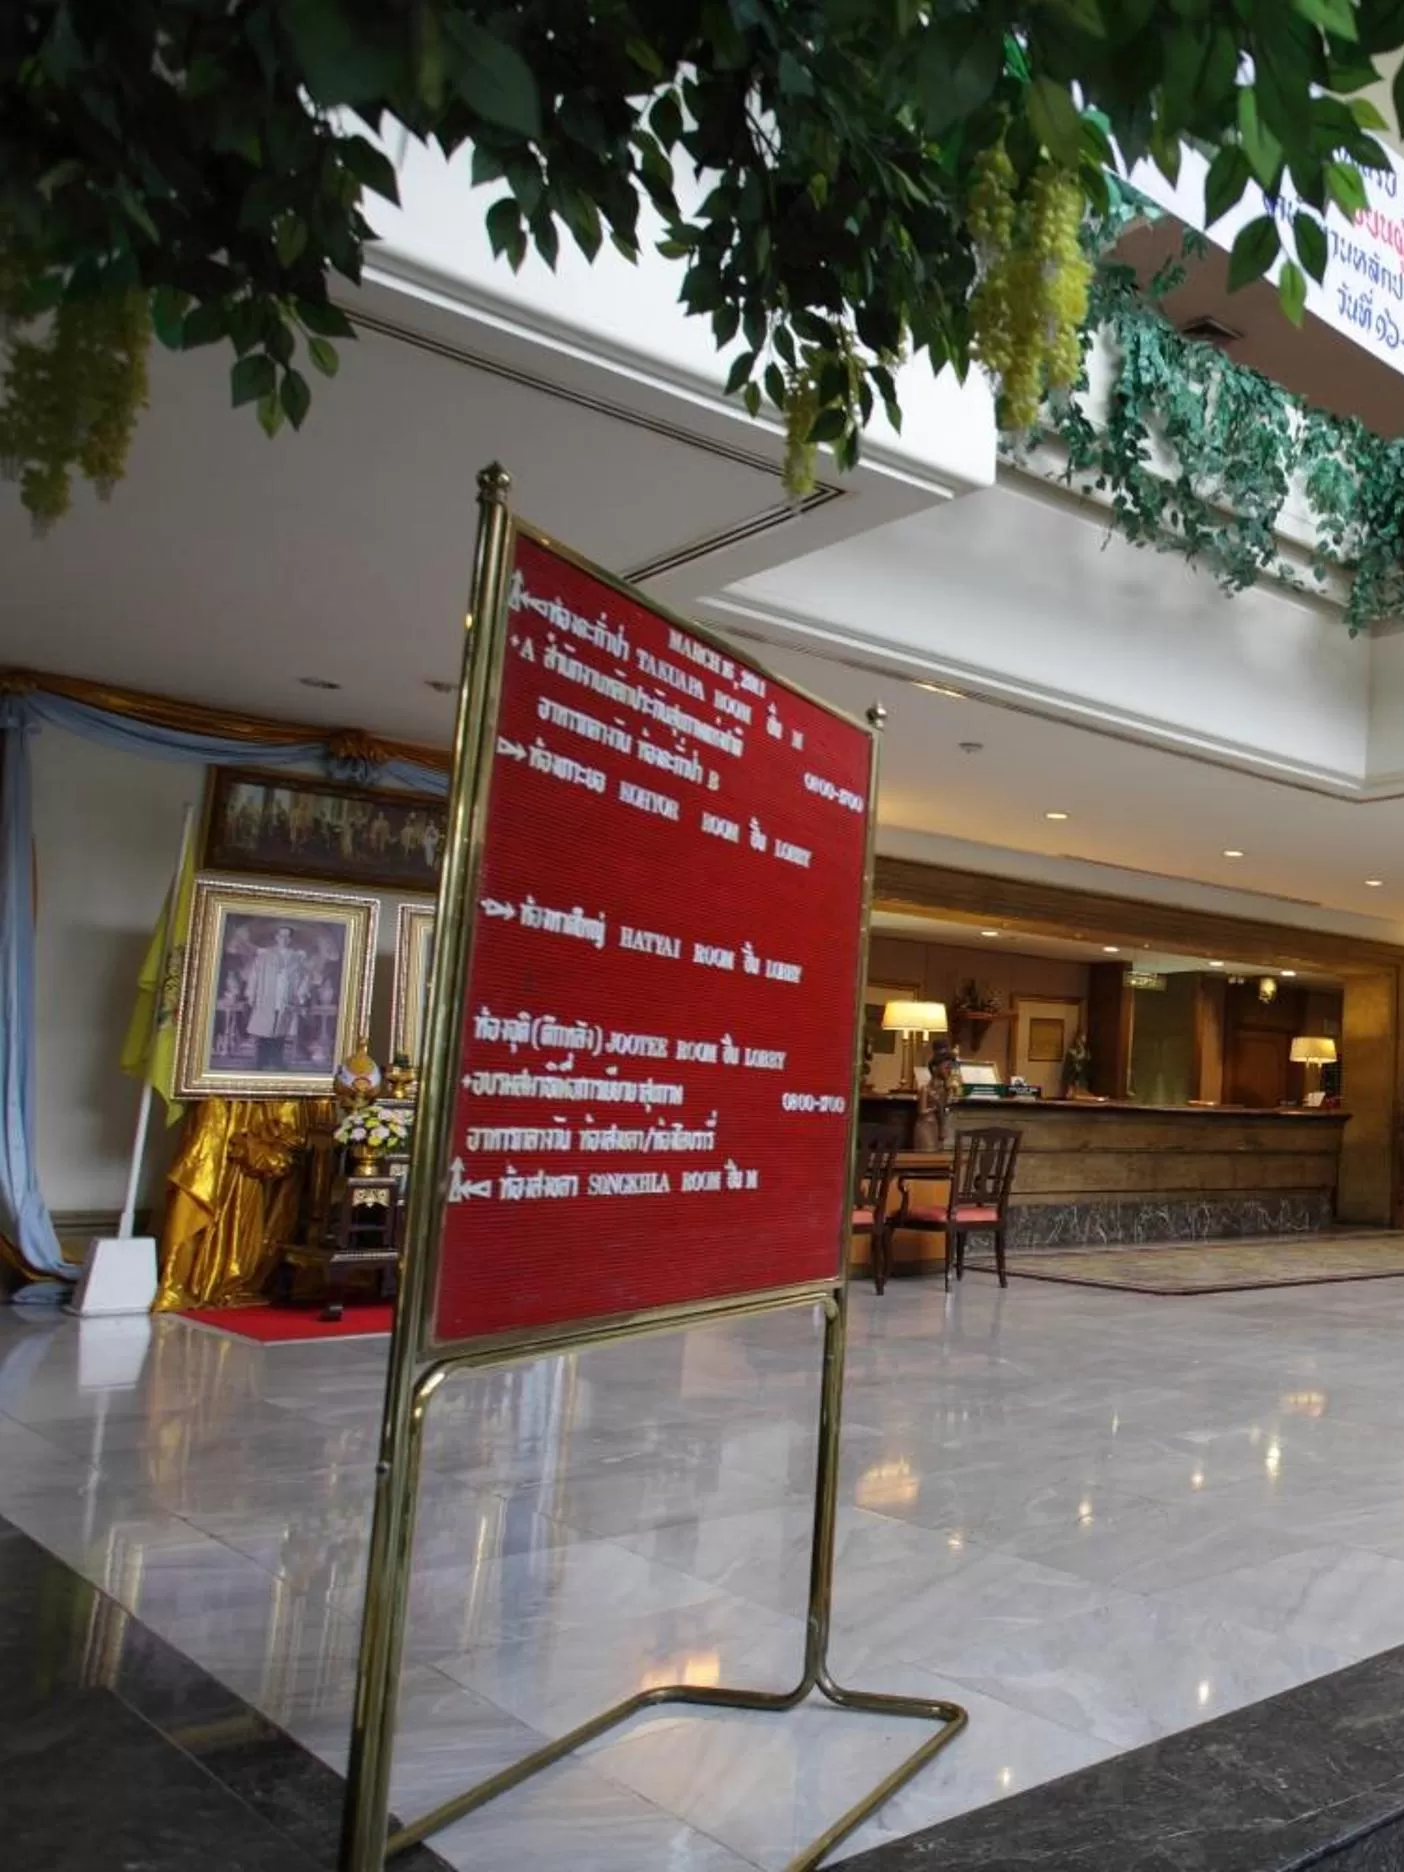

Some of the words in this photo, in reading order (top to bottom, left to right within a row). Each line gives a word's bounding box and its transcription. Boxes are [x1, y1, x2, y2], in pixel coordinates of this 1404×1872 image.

[1337, 281, 1373, 333] วันที่
[668, 628, 721, 674] MARCH
[714, 690, 752, 725] ROOM
[701, 811, 740, 844] ROOM
[774, 838, 812, 868] LOBBY
[620, 926, 681, 960] HATYAI
[693, 943, 734, 971] ROOM
[765, 958, 802, 984] LOBBY
[605, 1029, 668, 1060] JOOTEE
[676, 1036, 717, 1065] ROOM
[744, 1047, 787, 1070] LOBBY
[588, 1172, 670, 1196] SONGKHLA
[681, 1170, 722, 1193] ROOM
